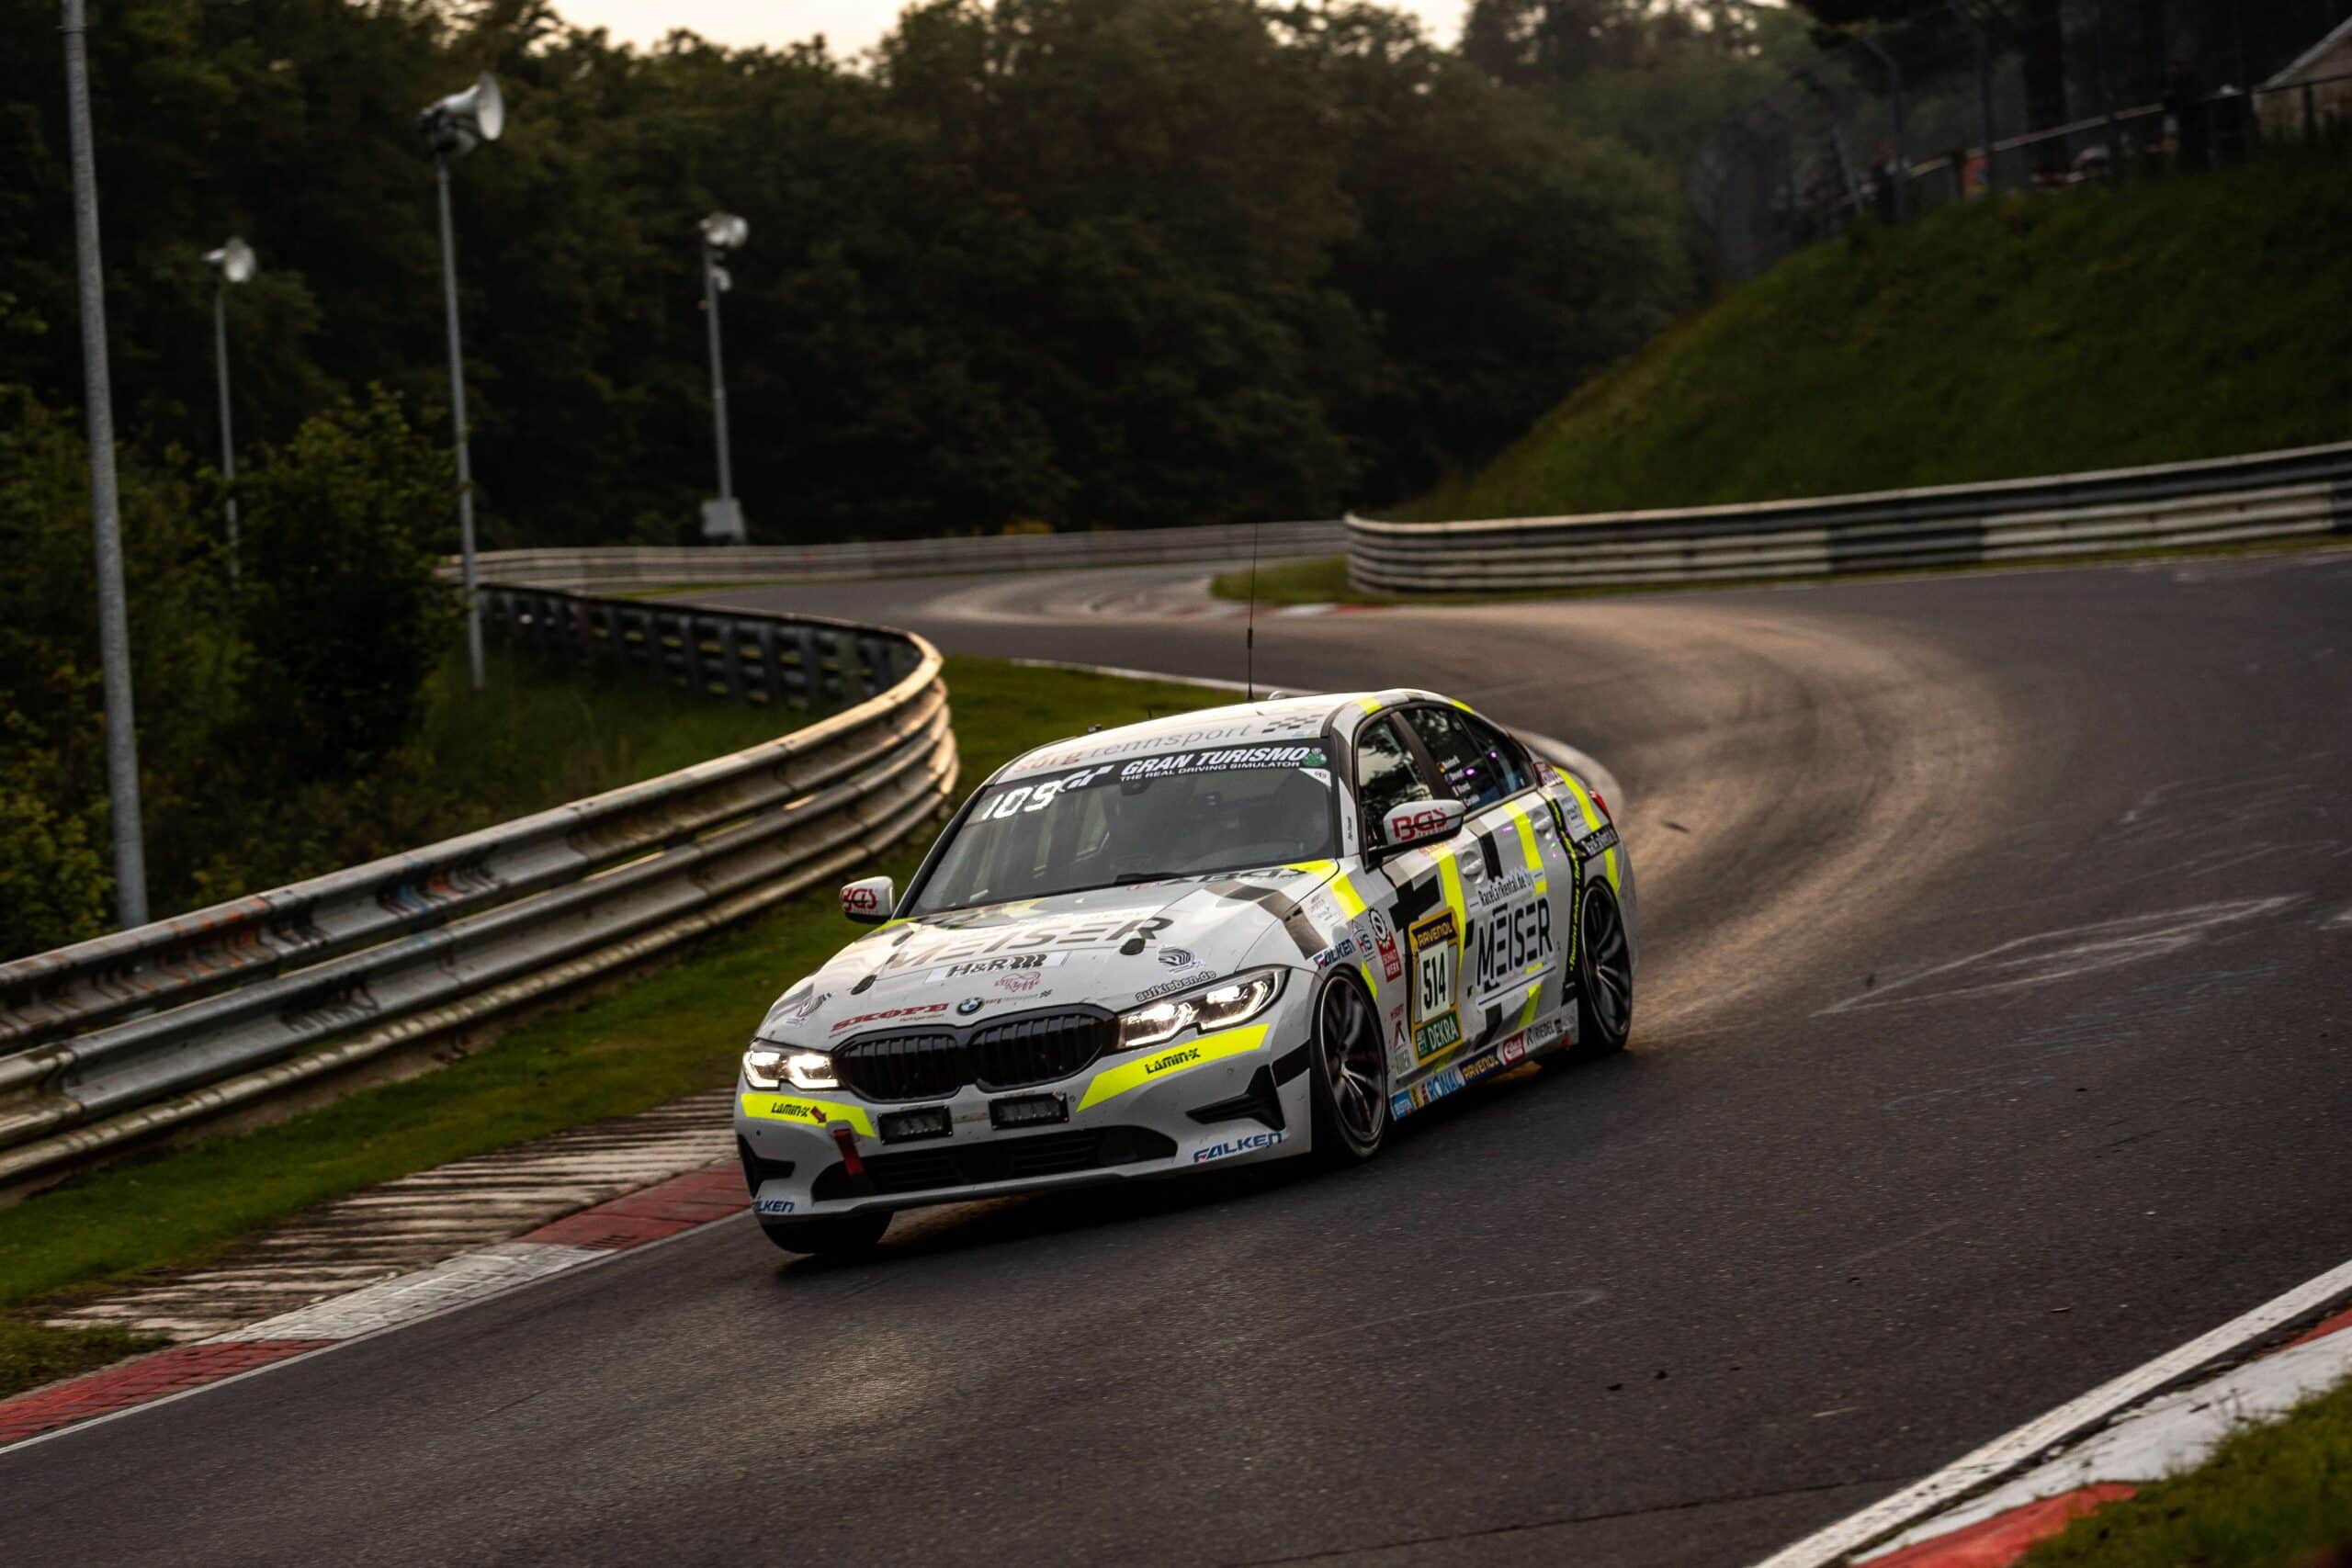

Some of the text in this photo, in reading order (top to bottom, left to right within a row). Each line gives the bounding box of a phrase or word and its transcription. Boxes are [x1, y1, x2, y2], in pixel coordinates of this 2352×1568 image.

[1091, 724, 1250, 758] rennsport
[1120, 761, 1300, 782] THE REAL DRIVING SIMULATOR
[1121, 746, 1310, 776] GRAN TURISMO
[1417, 921, 1453, 947] RAVENOL
[1476, 897, 1553, 987] MEISER
[946, 958, 1009, 977] H&R
[1313, 938, 1356, 970] FALKEN
[1136, 969, 1217, 1002] aufkleben.de
[1424, 951, 1445, 1010] 514
[1427, 1015, 1459, 1052] DEKRA
[1462, 1054, 1499, 1080] RAVENOL
[1193, 1132, 1283, 1163] FALKEN
